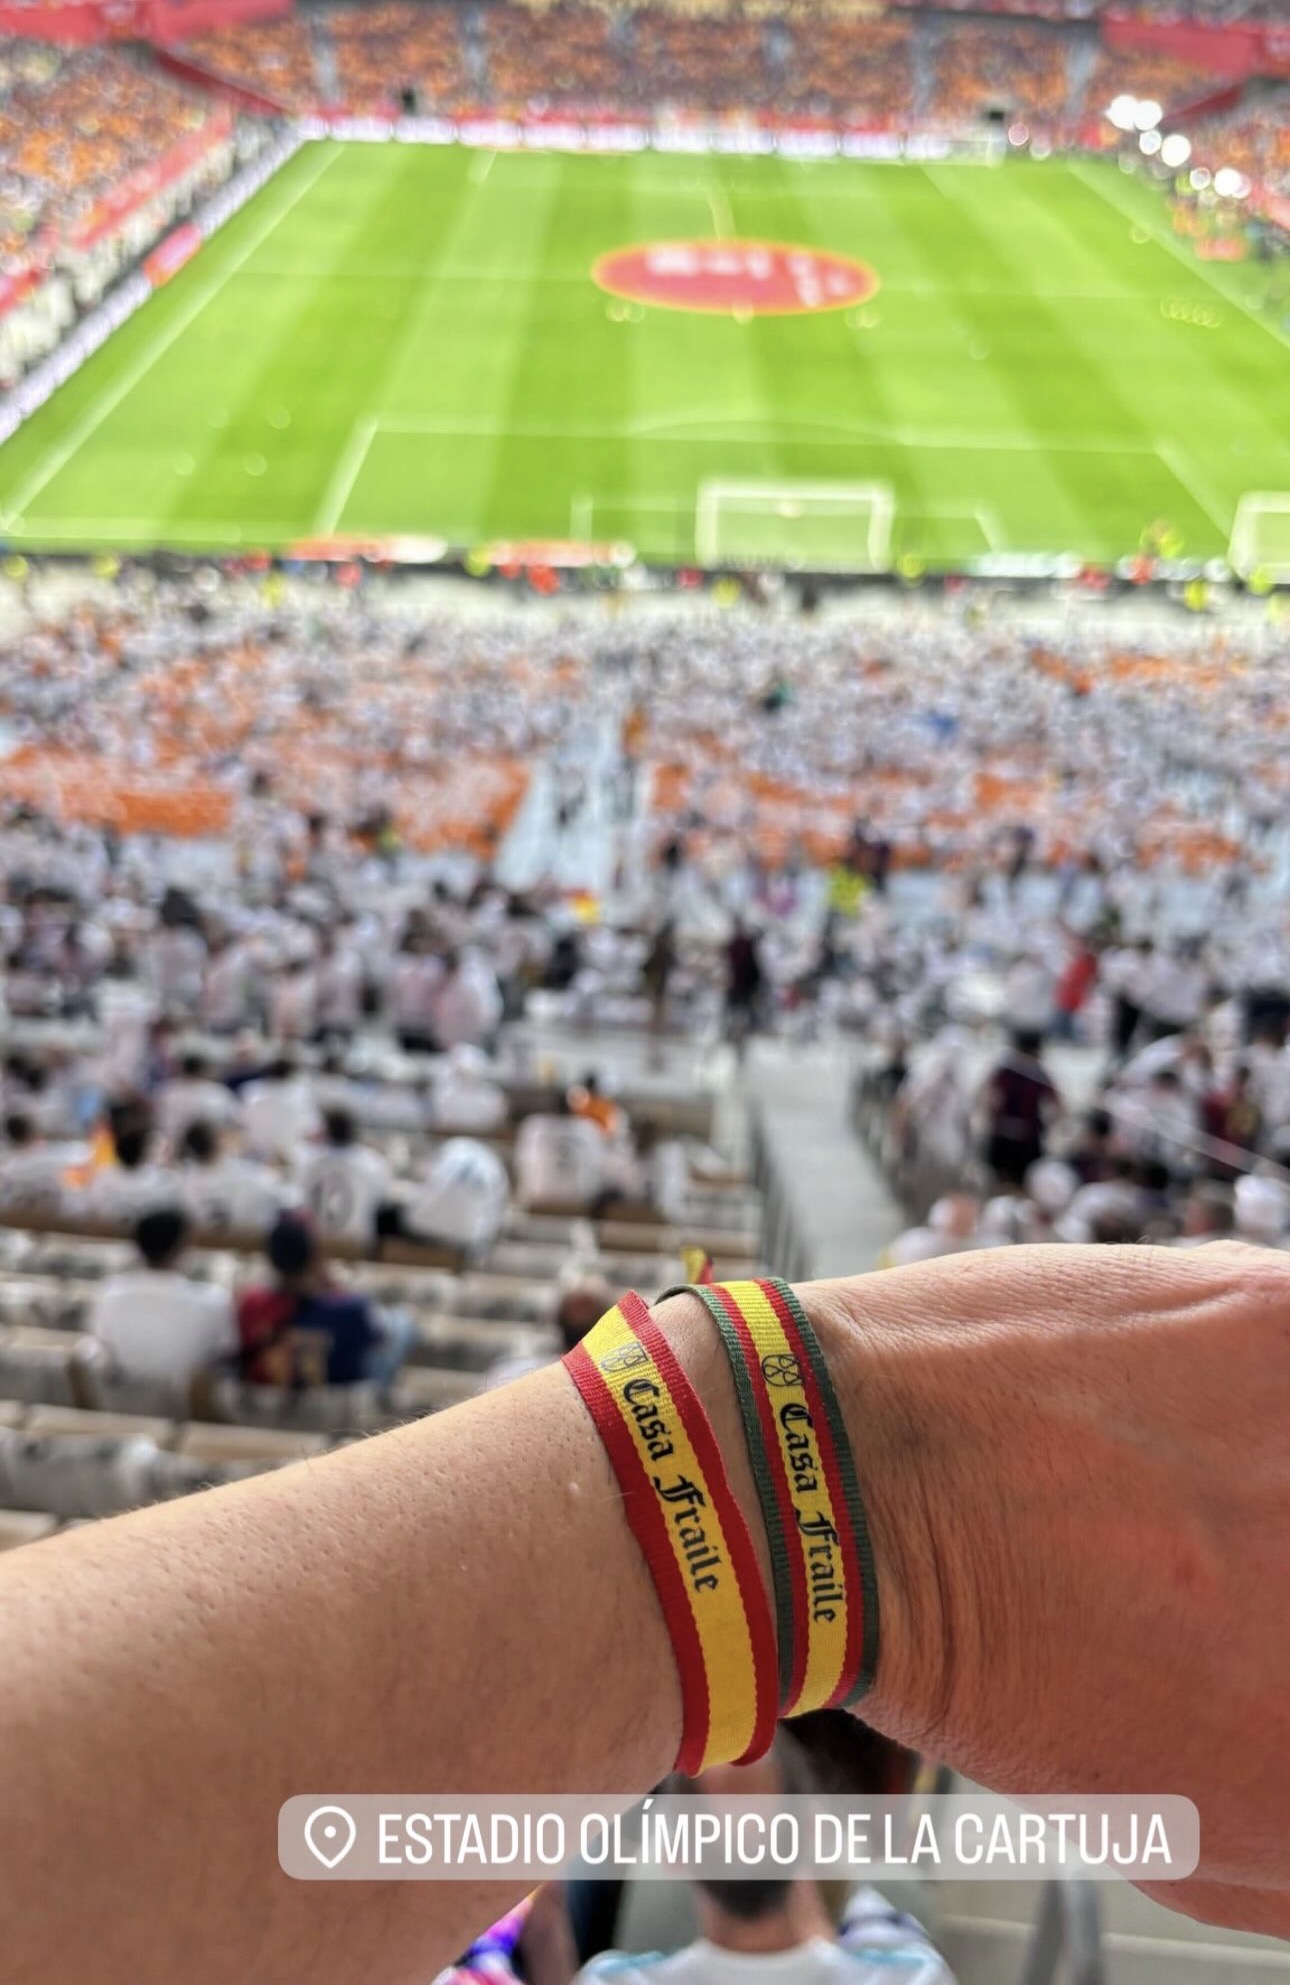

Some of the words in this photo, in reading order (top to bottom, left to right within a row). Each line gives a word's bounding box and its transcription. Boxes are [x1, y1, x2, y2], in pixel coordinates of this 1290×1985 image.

[622, 1378, 675, 1462] Casa
[652, 1474, 722, 1594] Fraile
[779, 1402, 818, 1493] Casa
[795, 1508, 844, 1624] Fraile
